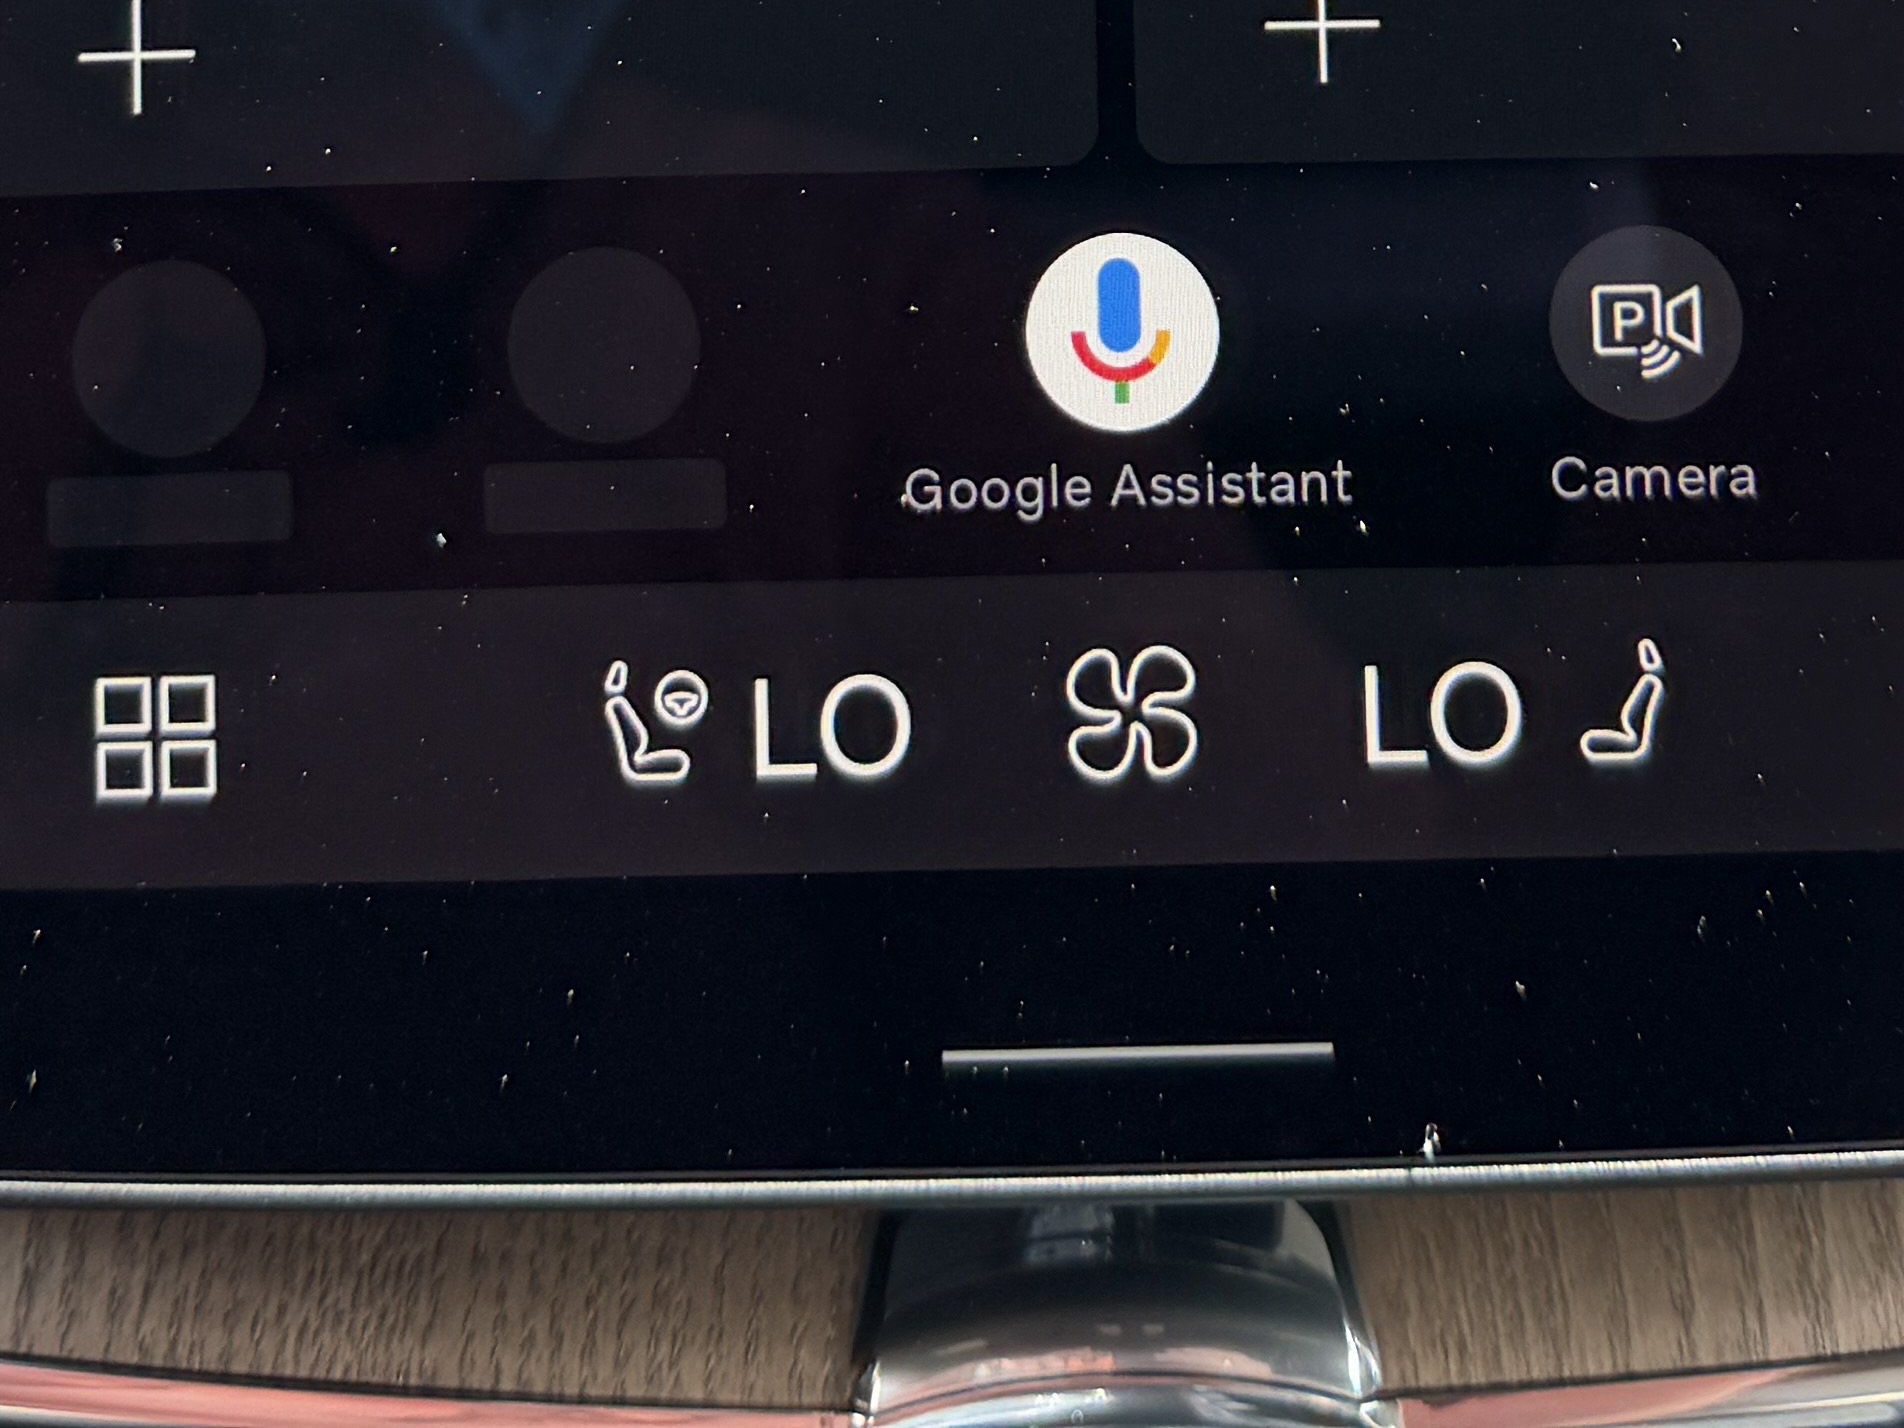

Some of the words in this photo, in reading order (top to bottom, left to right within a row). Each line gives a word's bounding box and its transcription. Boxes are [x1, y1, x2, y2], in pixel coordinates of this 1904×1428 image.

[901, 463, 1091, 521] Google
[1111, 460, 1352, 506] Assistant
[1552, 457, 1756, 498] Camera
[755, 674, 910, 780] LO
[1365, 662, 1521, 766] LO
